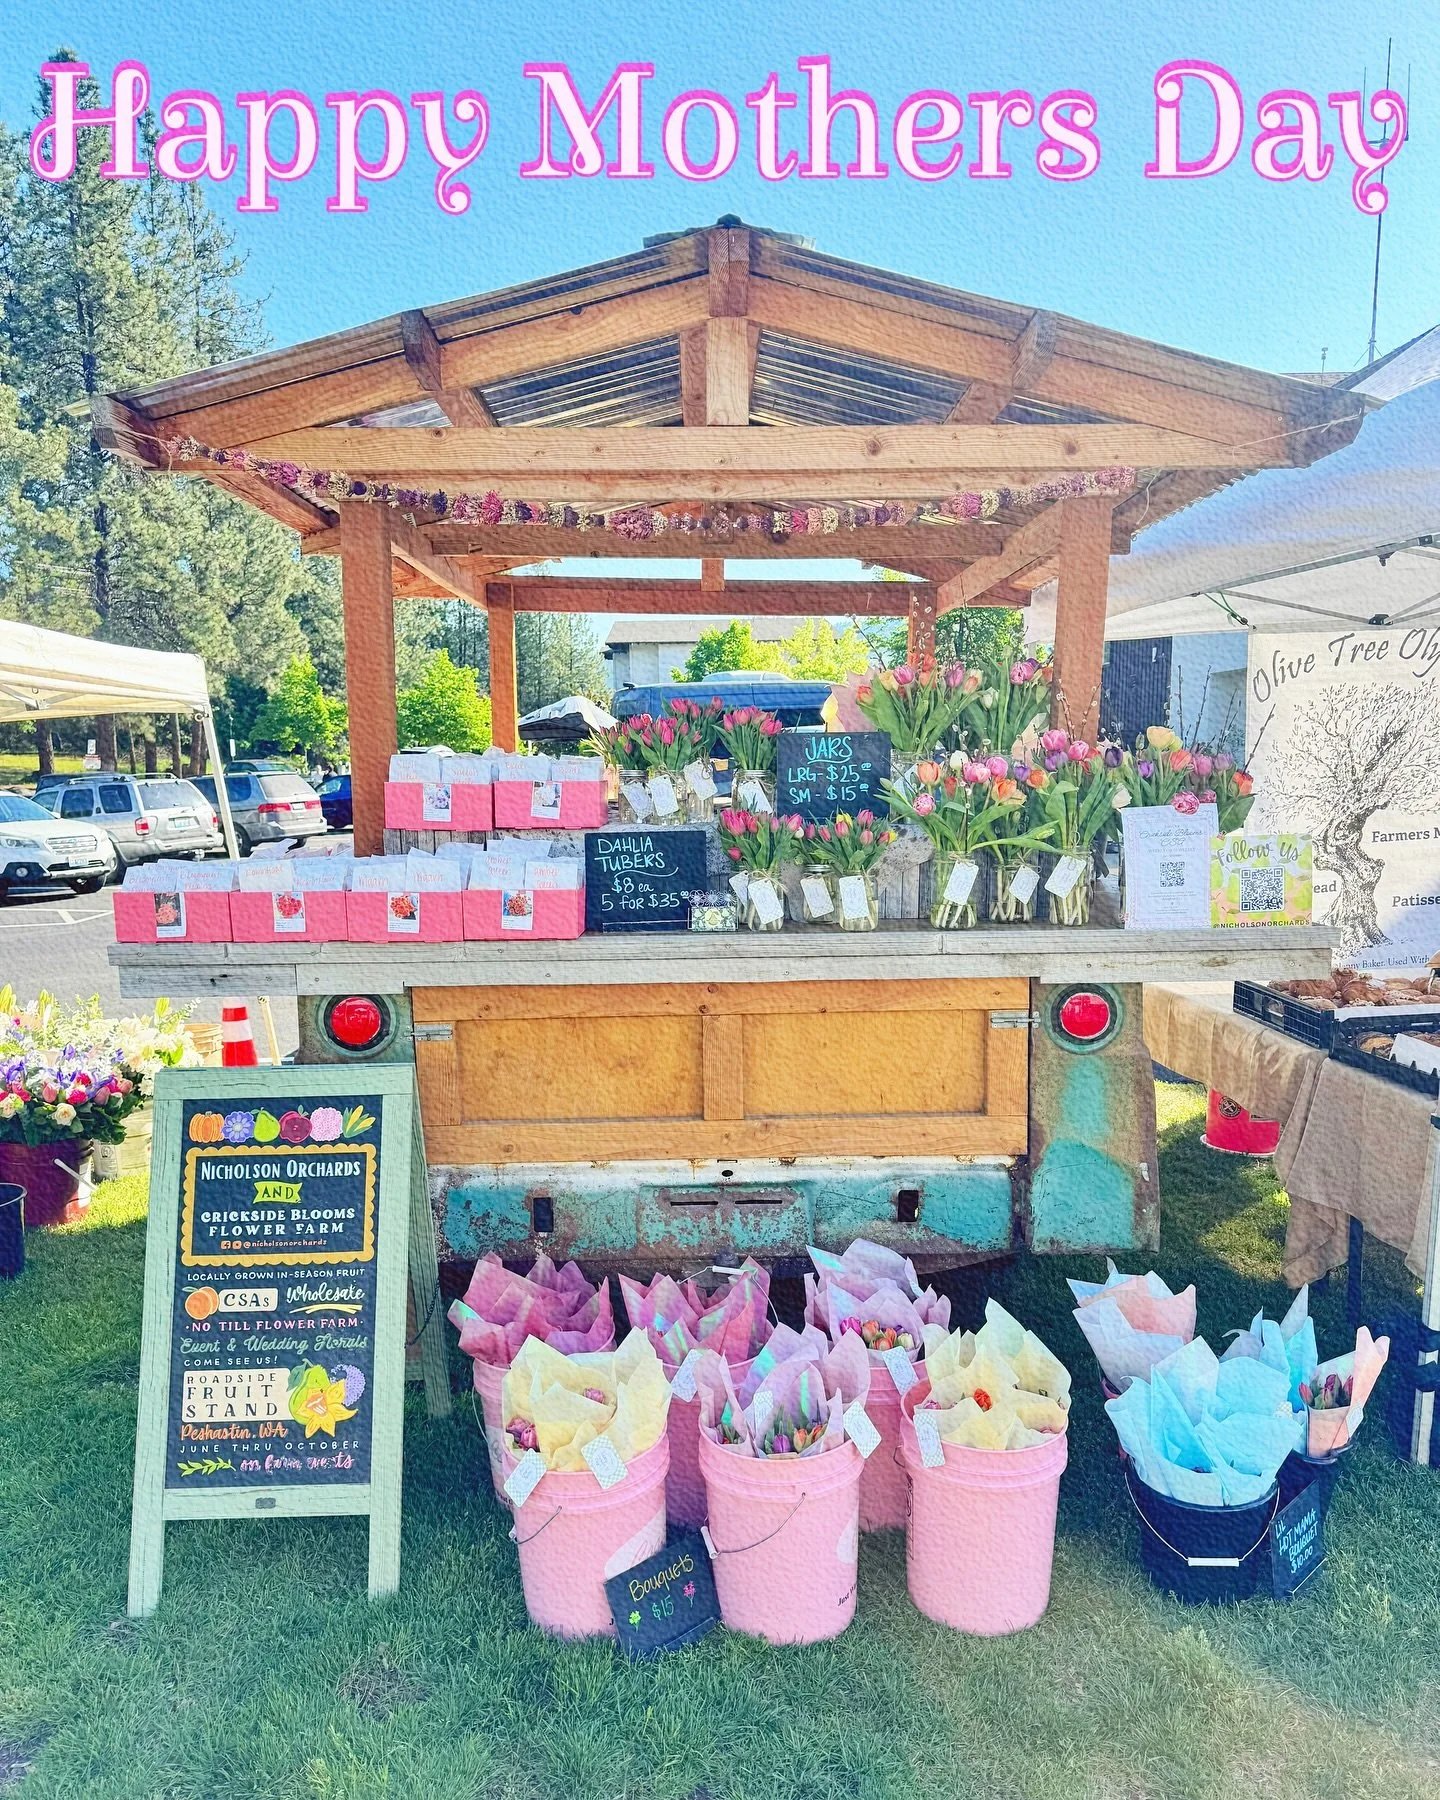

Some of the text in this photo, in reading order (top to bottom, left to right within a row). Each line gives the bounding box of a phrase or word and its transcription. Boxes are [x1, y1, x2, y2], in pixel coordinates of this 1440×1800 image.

[1253, 650, 1316, 703] Olive
[1328, 633, 1390, 667] Tree
[805, 736, 853, 761] JARS
[789, 787, 811, 805] SM
[1371, 830, 1430, 843] Farmers
[598, 836, 654, 854] DAHLIA
[1217, 839, 1301, 866] Follow Us
[594, 852, 665, 873] TUBERS
[611, 877, 654, 894] $8 ea
[1312, 880, 1337, 893] ead
[601, 893, 614, 912] 5
[1213, 920, 1310, 929] @NICHOLSONORCHARDS
[1388, 958, 1408, 966] Used
[1410, 955, 1430, 964] With
[201, 1160, 360, 1180] NICHOLSON ORCHARDS
[262, 1186, 294, 1199] AND
[201, 1208, 355, 1223] CRICKSIDE BLOOMS
[209, 1222, 344, 1236] FLOWER FARM
[243, 1239, 327, 1248] @nicholsonorchards
[187, 1268, 365, 1281] LOCALLY GROWN IN-SEASON FRUIT
[224, 1293, 269, 1307] CSAs
[192, 1318, 358, 1332] NO TILL FLOWER FARM
[180, 1333, 368, 1355] Event & Wedding Florals
[184, 1355, 278, 1367] COME SEE US!
[187, 1373, 276, 1384] ROADSIDE
[187, 1385, 273, 1400] FRUIT
[186, 1402, 278, 1418] STAND
[259, 1421, 288, 1438] WA
[180, 1441, 359, 1453] JUNE THRU OCTOBER
[628, 1553, 695, 1603] Bouquets
[651, 1594, 675, 1621] $15
